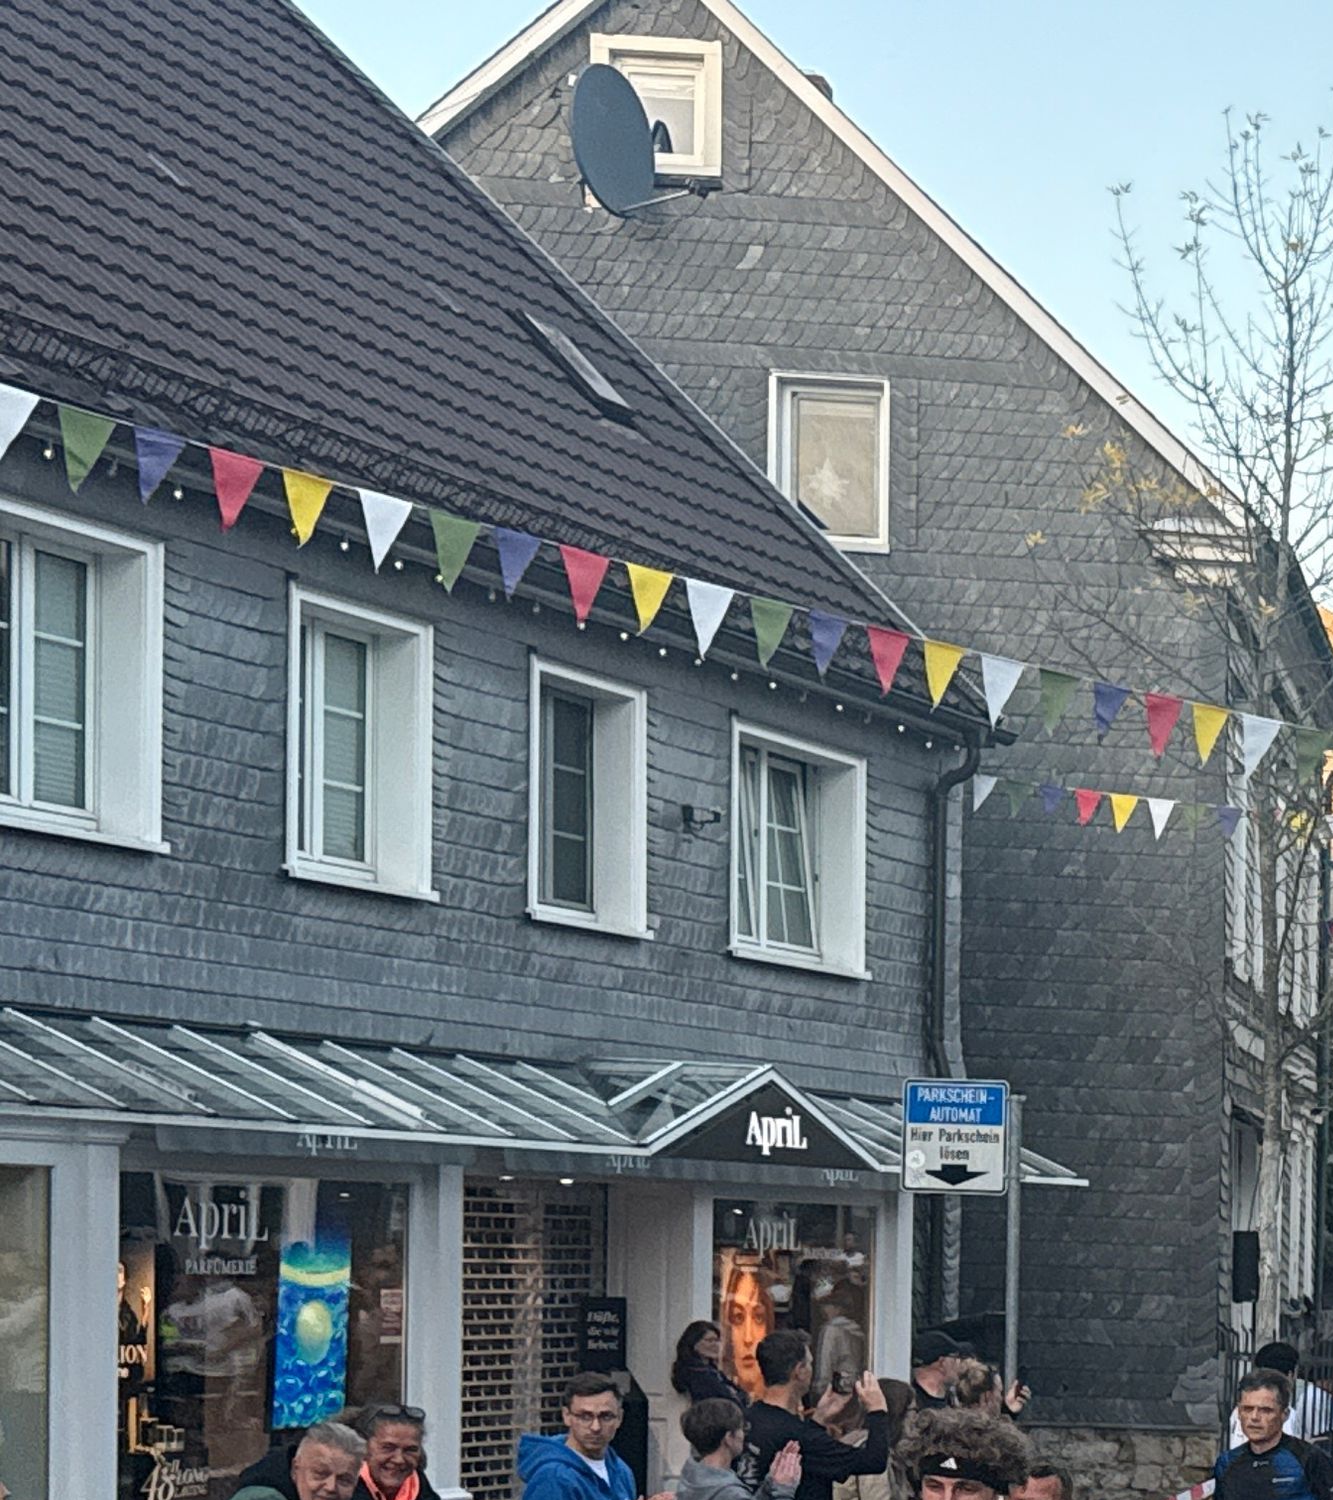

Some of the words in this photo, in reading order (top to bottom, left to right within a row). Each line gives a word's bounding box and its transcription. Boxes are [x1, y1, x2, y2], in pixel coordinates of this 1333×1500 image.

[917, 1086, 995, 1105] PARKSCHEIN-
[929, 1106, 983, 1122] AUTOMAT
[910, 1127, 933, 1142] Hier
[938, 1128, 1000, 1144] Parkschein
[940, 1146, 970, 1160] lösen
